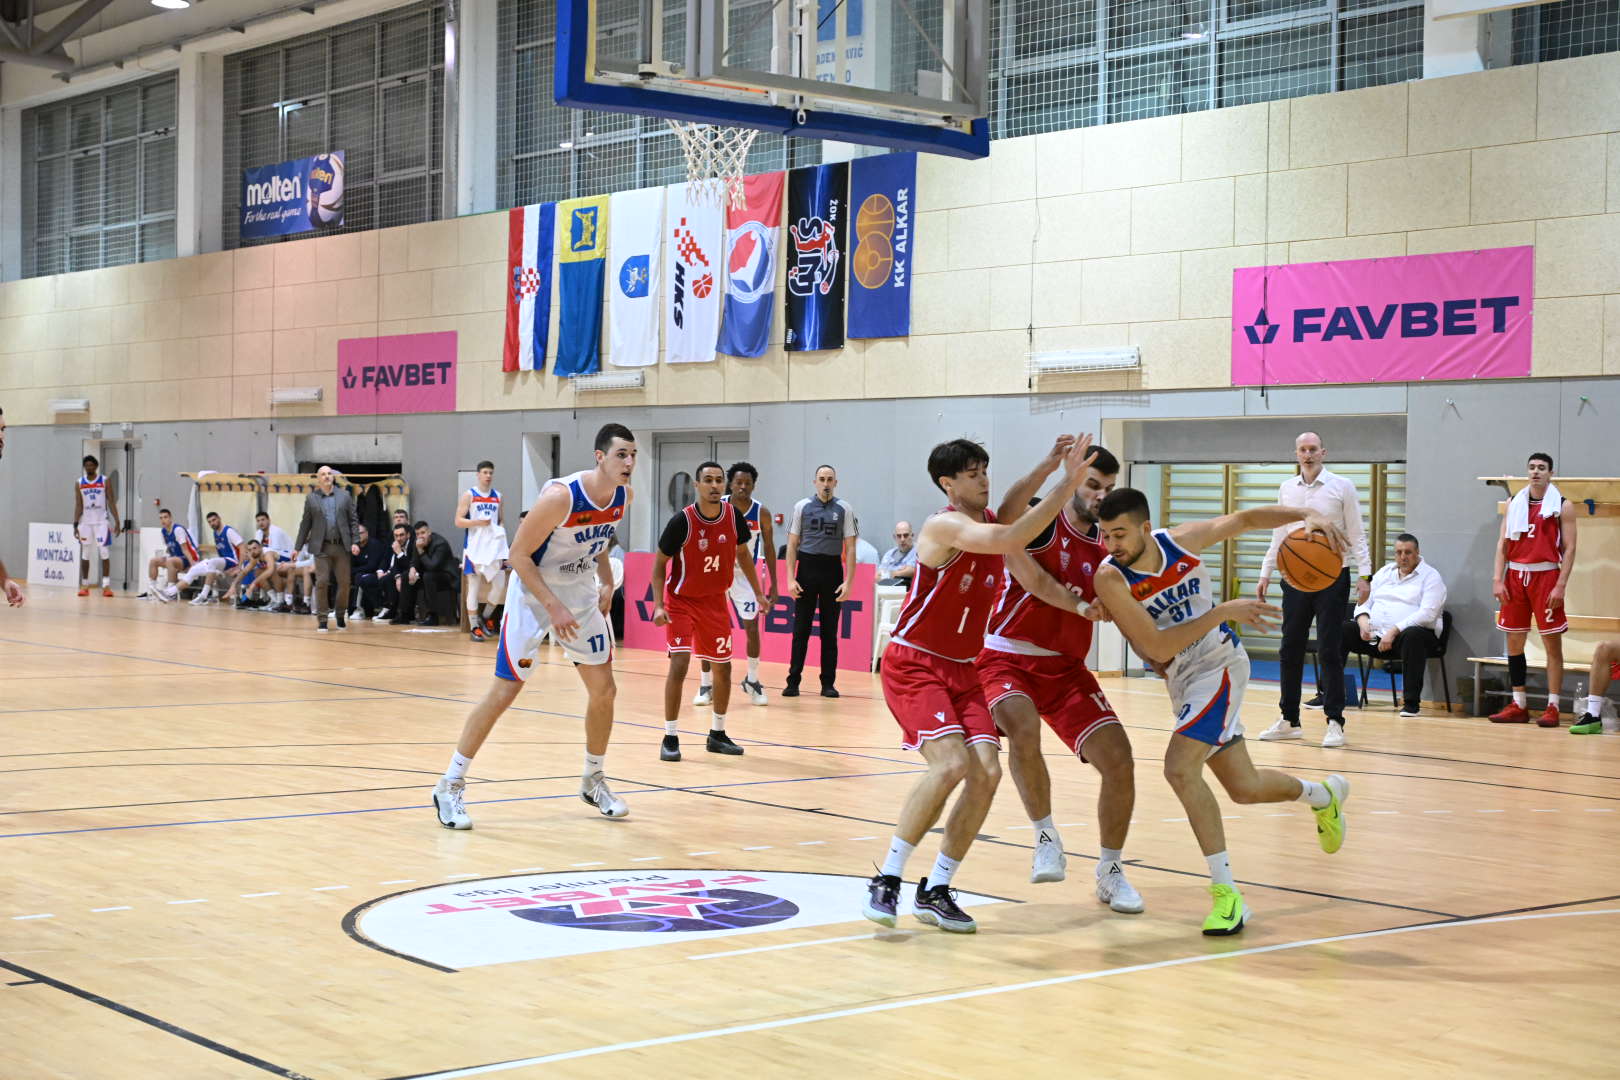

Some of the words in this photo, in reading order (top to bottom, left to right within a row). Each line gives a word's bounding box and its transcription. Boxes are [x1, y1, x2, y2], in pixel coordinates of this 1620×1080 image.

[247, 176, 302, 206] molten
[896, 187, 908, 254] ALKAR
[894, 260, 905, 288] KK
[673, 261, 685, 330] HKS
[1293, 296, 1519, 343] FAVBET
[362, 362, 452, 388] FAVBET
[1527, 523, 1536, 538] 2
[36, 547, 74, 562] MONTAŽA
[703, 555, 720, 573] 24
[44, 568, 65, 580] d.o.o.
[743, 601, 756, 613] 21
[1146, 577, 1200, 620] ALKAR
[957, 606, 970, 634] 1
[1545, 608, 1555, 623] 2
[587, 633, 605, 653] 17
[716, 635, 732, 654] 24
[425, 875, 768, 915] FAVBET
